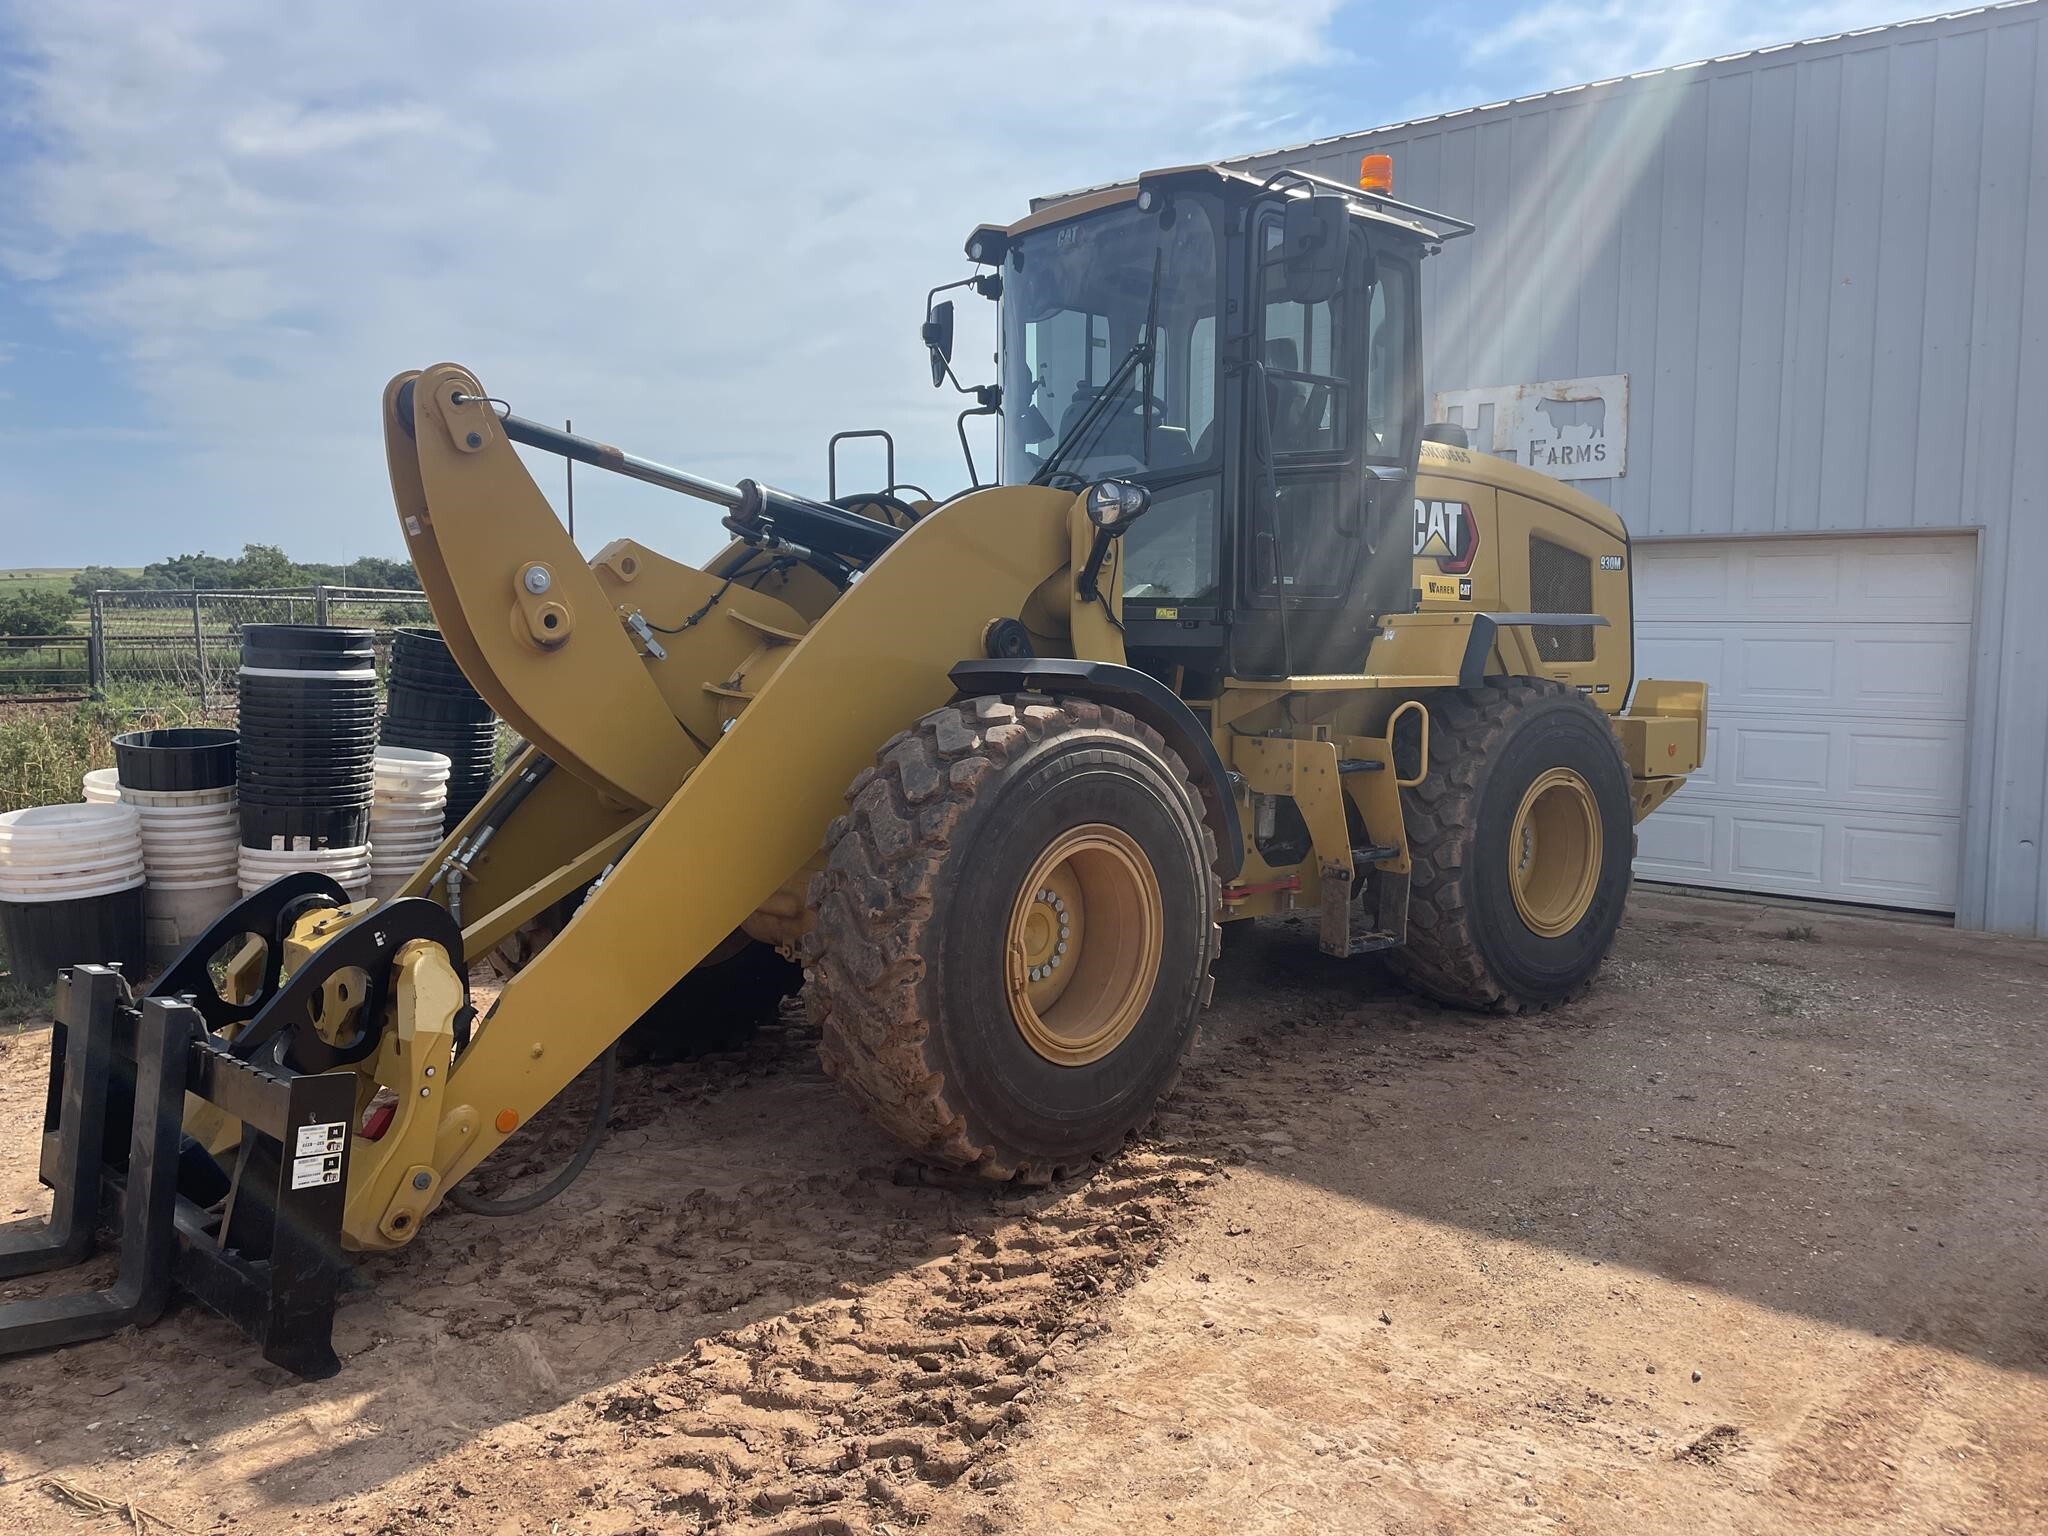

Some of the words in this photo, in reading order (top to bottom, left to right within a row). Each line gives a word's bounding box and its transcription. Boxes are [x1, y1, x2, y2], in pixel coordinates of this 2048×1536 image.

[1057, 226, 1079, 248] CAT
[1529, 439, 1606, 466] FARMS
[1413, 499, 1462, 556] CAT
[1600, 556, 1621, 570] 930M
[1429, 581, 1455, 594] WARREN
[1460, 583, 1471, 596] CAT
